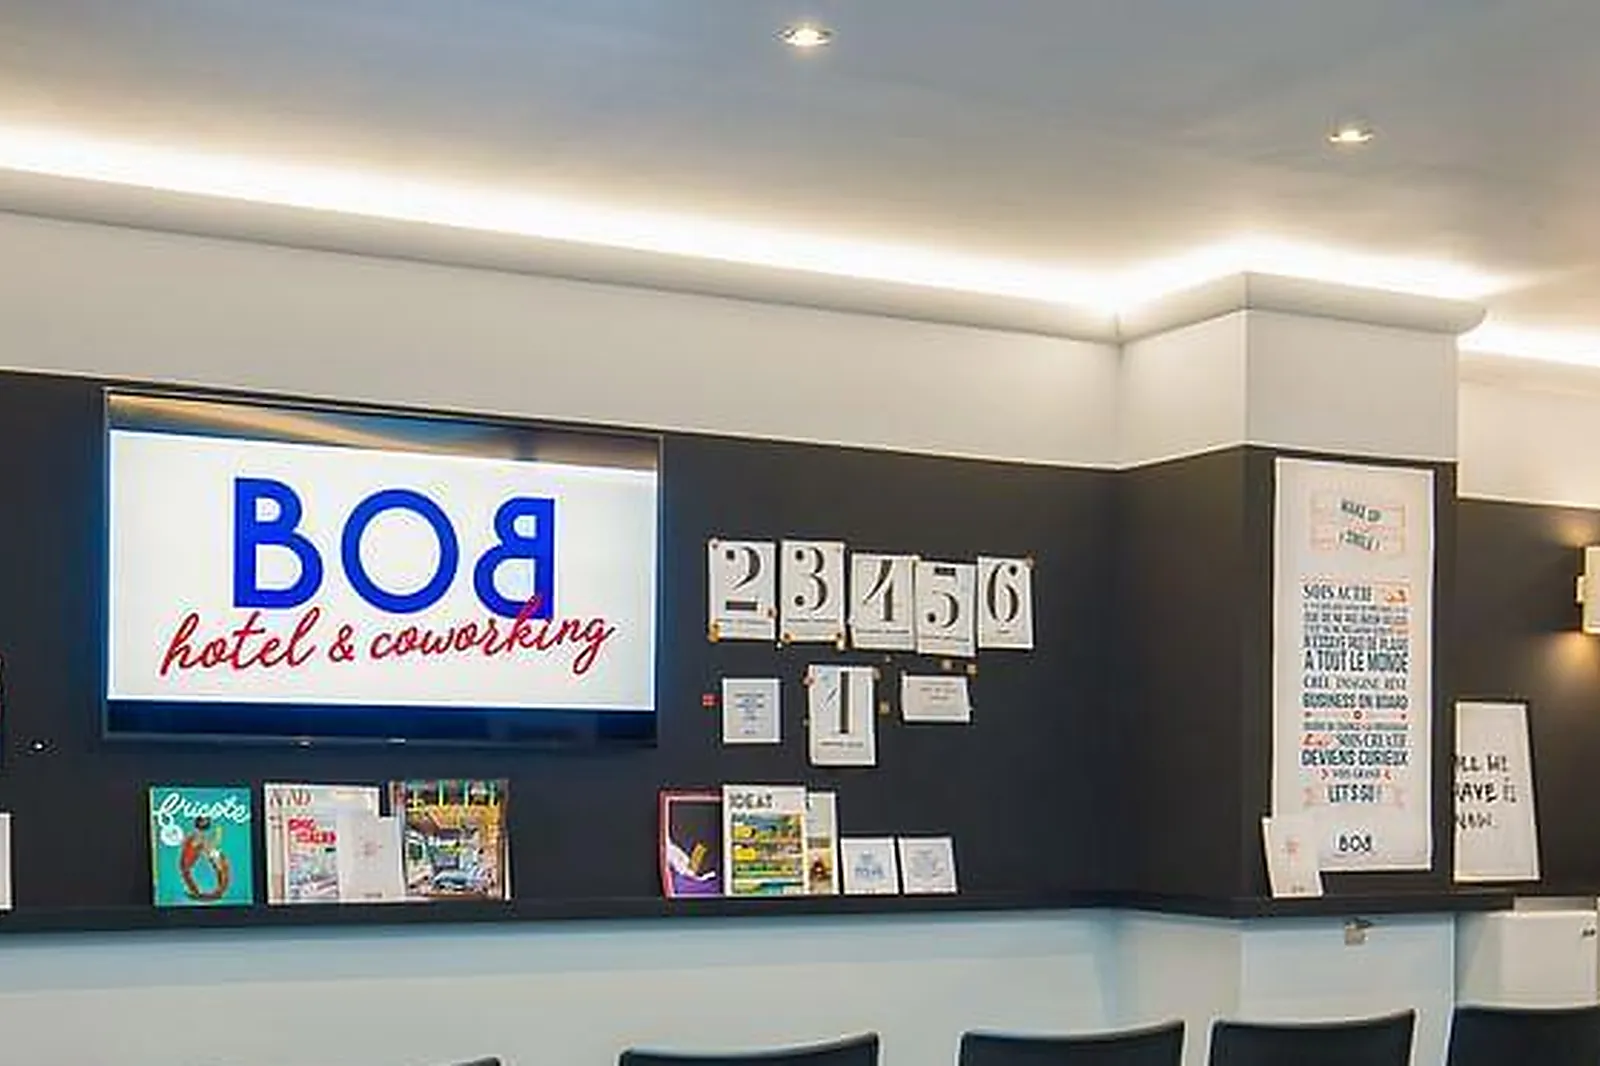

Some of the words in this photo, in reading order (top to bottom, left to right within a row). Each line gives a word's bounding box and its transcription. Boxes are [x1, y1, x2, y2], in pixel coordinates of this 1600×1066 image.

[234, 477, 555, 619] BOB
[726, 546, 761, 611] 2
[794, 546, 828, 611] 3
[863, 559, 900, 622] 4
[926, 566, 959, 628] 5
[986, 561, 1019, 623] 6
[160, 606, 321, 677] hotel
[327, 626, 355, 661] &
[370, 596, 617, 674] coworking
[1317, 650, 1348, 671] TOUT
[1350, 651, 1365, 672] LE
[1367, 651, 1408, 673] MONDE
[822, 670, 851, 734] 1
